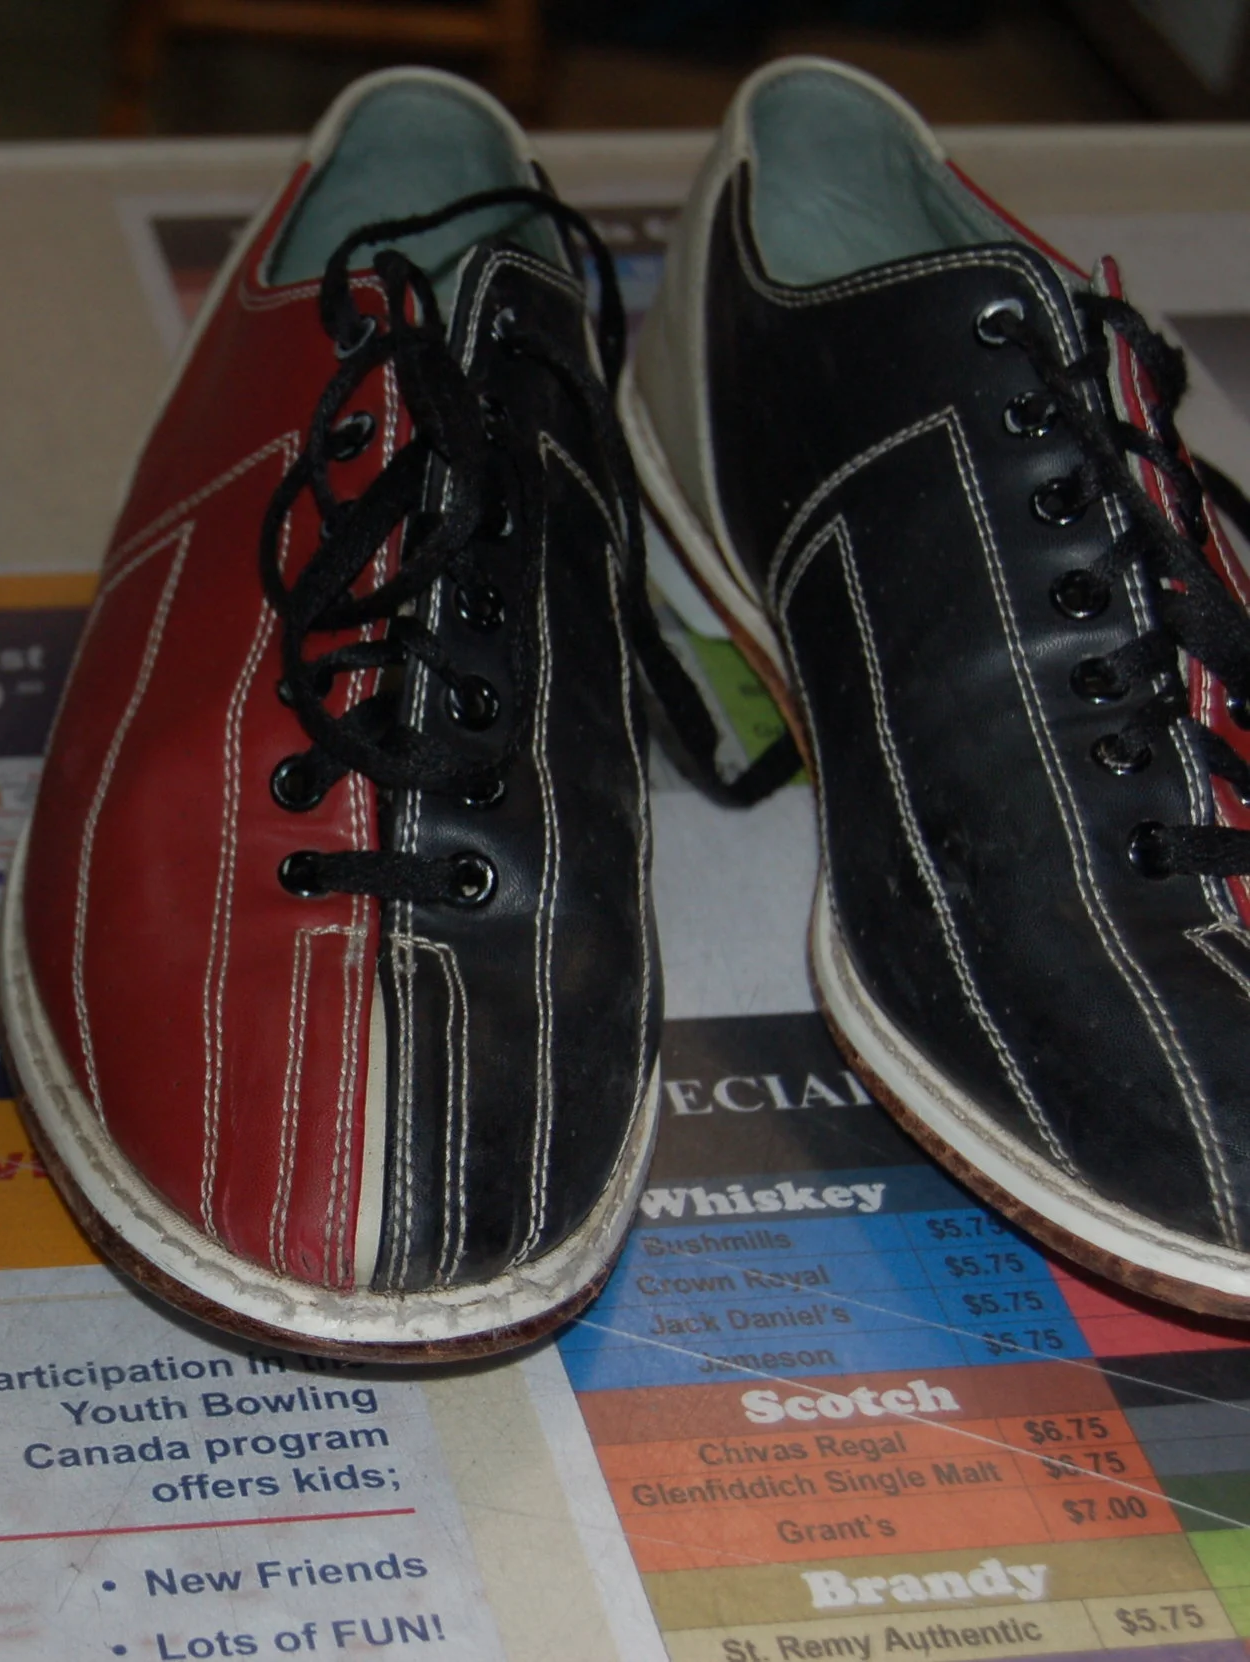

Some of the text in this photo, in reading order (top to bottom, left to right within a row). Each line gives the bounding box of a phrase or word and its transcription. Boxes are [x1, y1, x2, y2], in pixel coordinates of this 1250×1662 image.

[638, 1180, 887, 1219] Whiskey
[642, 1229, 793, 1257] Bushmills
[636, 1264, 830, 1297] Crown Royal
[944, 1252, 1025, 1277] $5.75
[651, 1303, 851, 1336] Jack Daniel's
[962, 1291, 1043, 1316] $5.75
[247, 1351, 286, 1374] in
[699, 1347, 836, 1374] Jameson
[61, 1385, 378, 1426] Youth Bowling
[740, 1379, 961, 1424] Scotch
[1024, 1416, 1109, 1445] $6.75
[23, 1427, 390, 1469] Canada program
[698, 1430, 908, 1466] Chivas Regal
[151, 1464, 401, 1502] offers kids;
[632, 1458, 1002, 1508] Glenfiddich Single Malt
[1062, 1495, 1148, 1525] $7.00
[776, 1513, 897, 1545] Grant's
[145, 1552, 429, 1596] New Friends
[800, 1557, 1048, 1609] Brandy
[1115, 1604, 1205, 1635] $5.75
[157, 1613, 447, 1662] Lots of FUN!
[722, 1617, 1043, 1662] St. Remy Authentic
